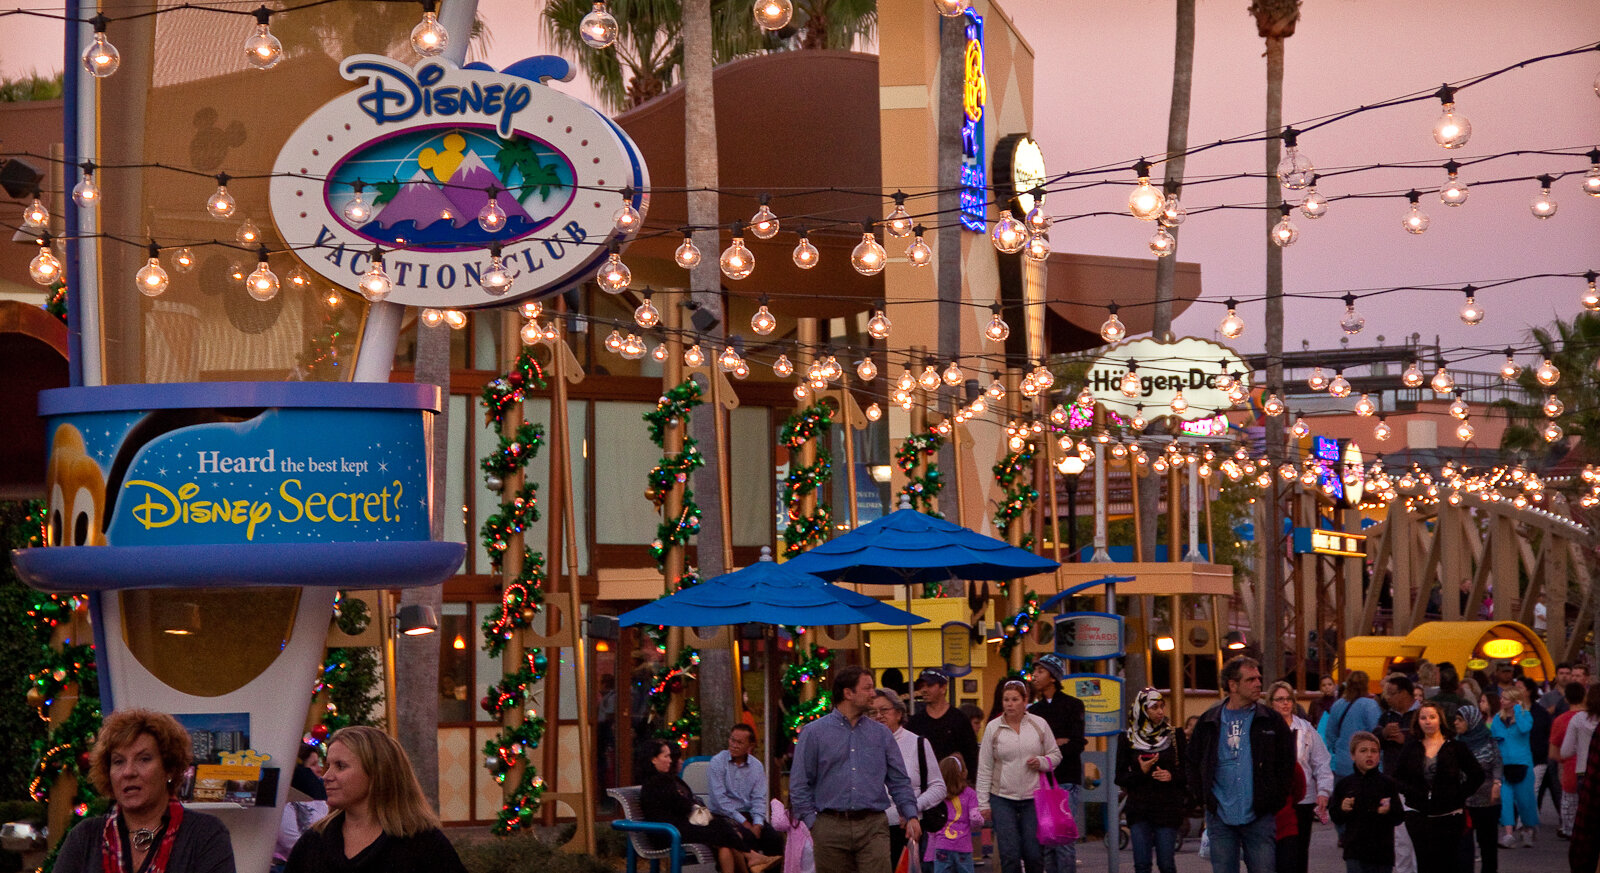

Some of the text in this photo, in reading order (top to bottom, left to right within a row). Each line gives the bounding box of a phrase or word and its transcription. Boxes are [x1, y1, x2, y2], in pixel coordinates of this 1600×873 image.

[346, 62, 532, 136] Disney
[501, 219, 588, 280] CLUB
[196, 449, 369, 477] Heard the best kept
[124, 478, 404, 541] Disney Secret?
